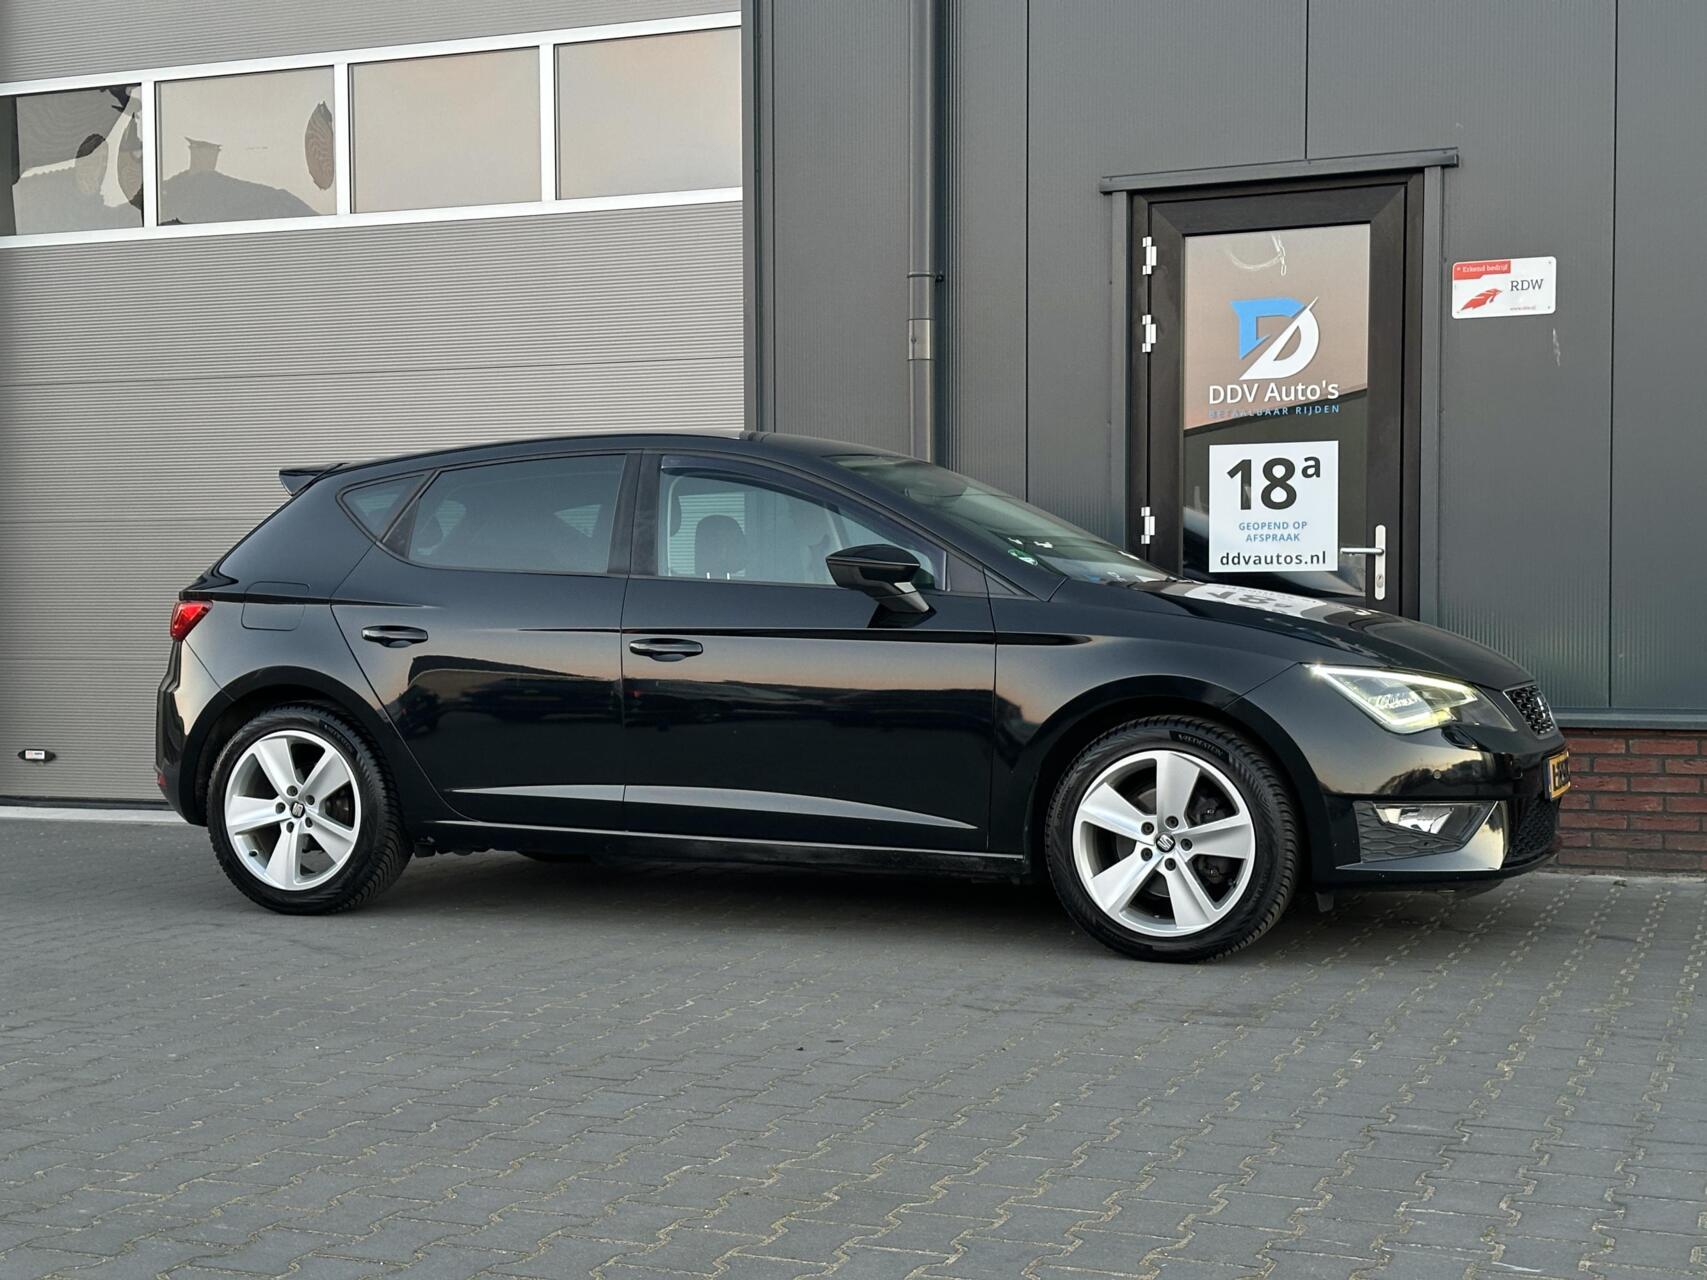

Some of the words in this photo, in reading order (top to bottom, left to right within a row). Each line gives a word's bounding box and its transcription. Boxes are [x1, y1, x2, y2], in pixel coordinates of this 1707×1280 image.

[1510, 279, 1544, 291] RDW
[1209, 383, 1259, 405] DDV
[1264, 380, 1340, 402] Auto's
[1208, 408, 1289, 418] BEAALBAAR
[1295, 404, 1340, 416] RIJDEN
[1238, 521, 1289, 531] GEOPEND
[1292, 521, 1308, 530] OP
[1245, 533, 1301, 543] AFSPRAAK
[1220, 551, 1327, 566] ddvautos.nl
